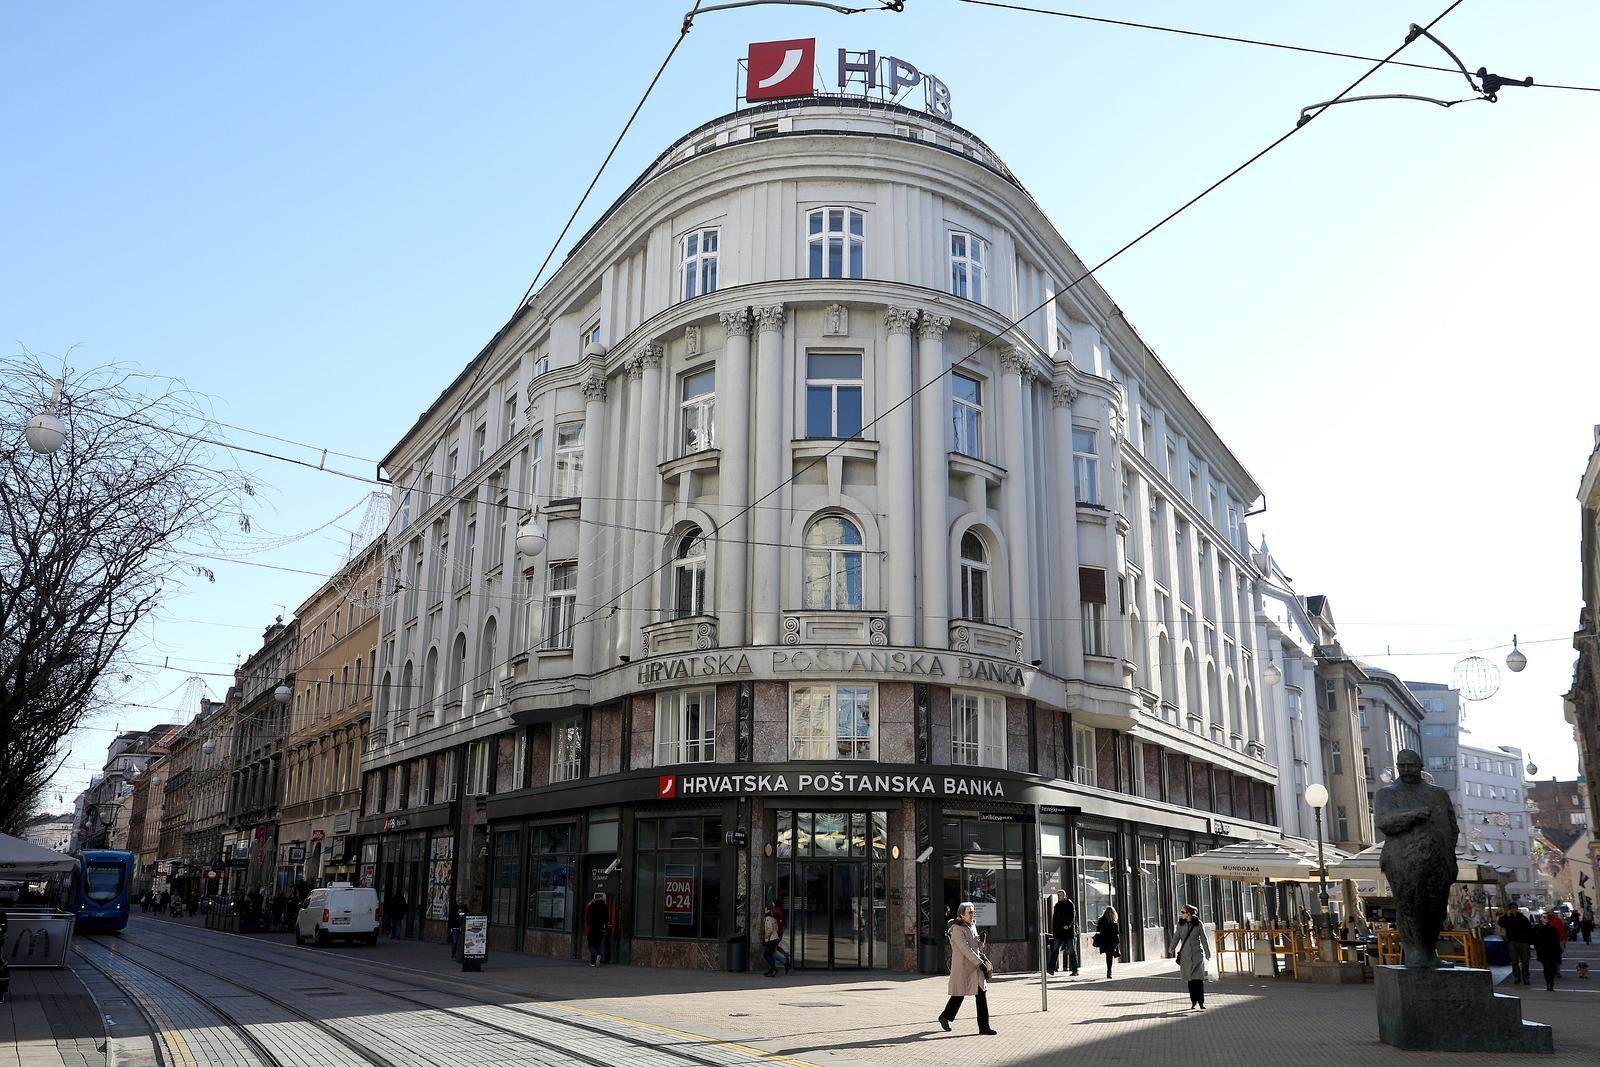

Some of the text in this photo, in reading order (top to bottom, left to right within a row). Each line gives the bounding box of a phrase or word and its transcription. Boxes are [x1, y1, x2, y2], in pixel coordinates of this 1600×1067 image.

[838, 48, 952, 121] HPB
[638, 654, 753, 685] HRVATSKA
[958, 658, 1025, 687] BANKA
[683, 772, 1005, 797] HRVATSKA POŠTANSKA BANKA
[666, 881, 691, 892] ZONA
[666, 894, 691, 908] 0-24
